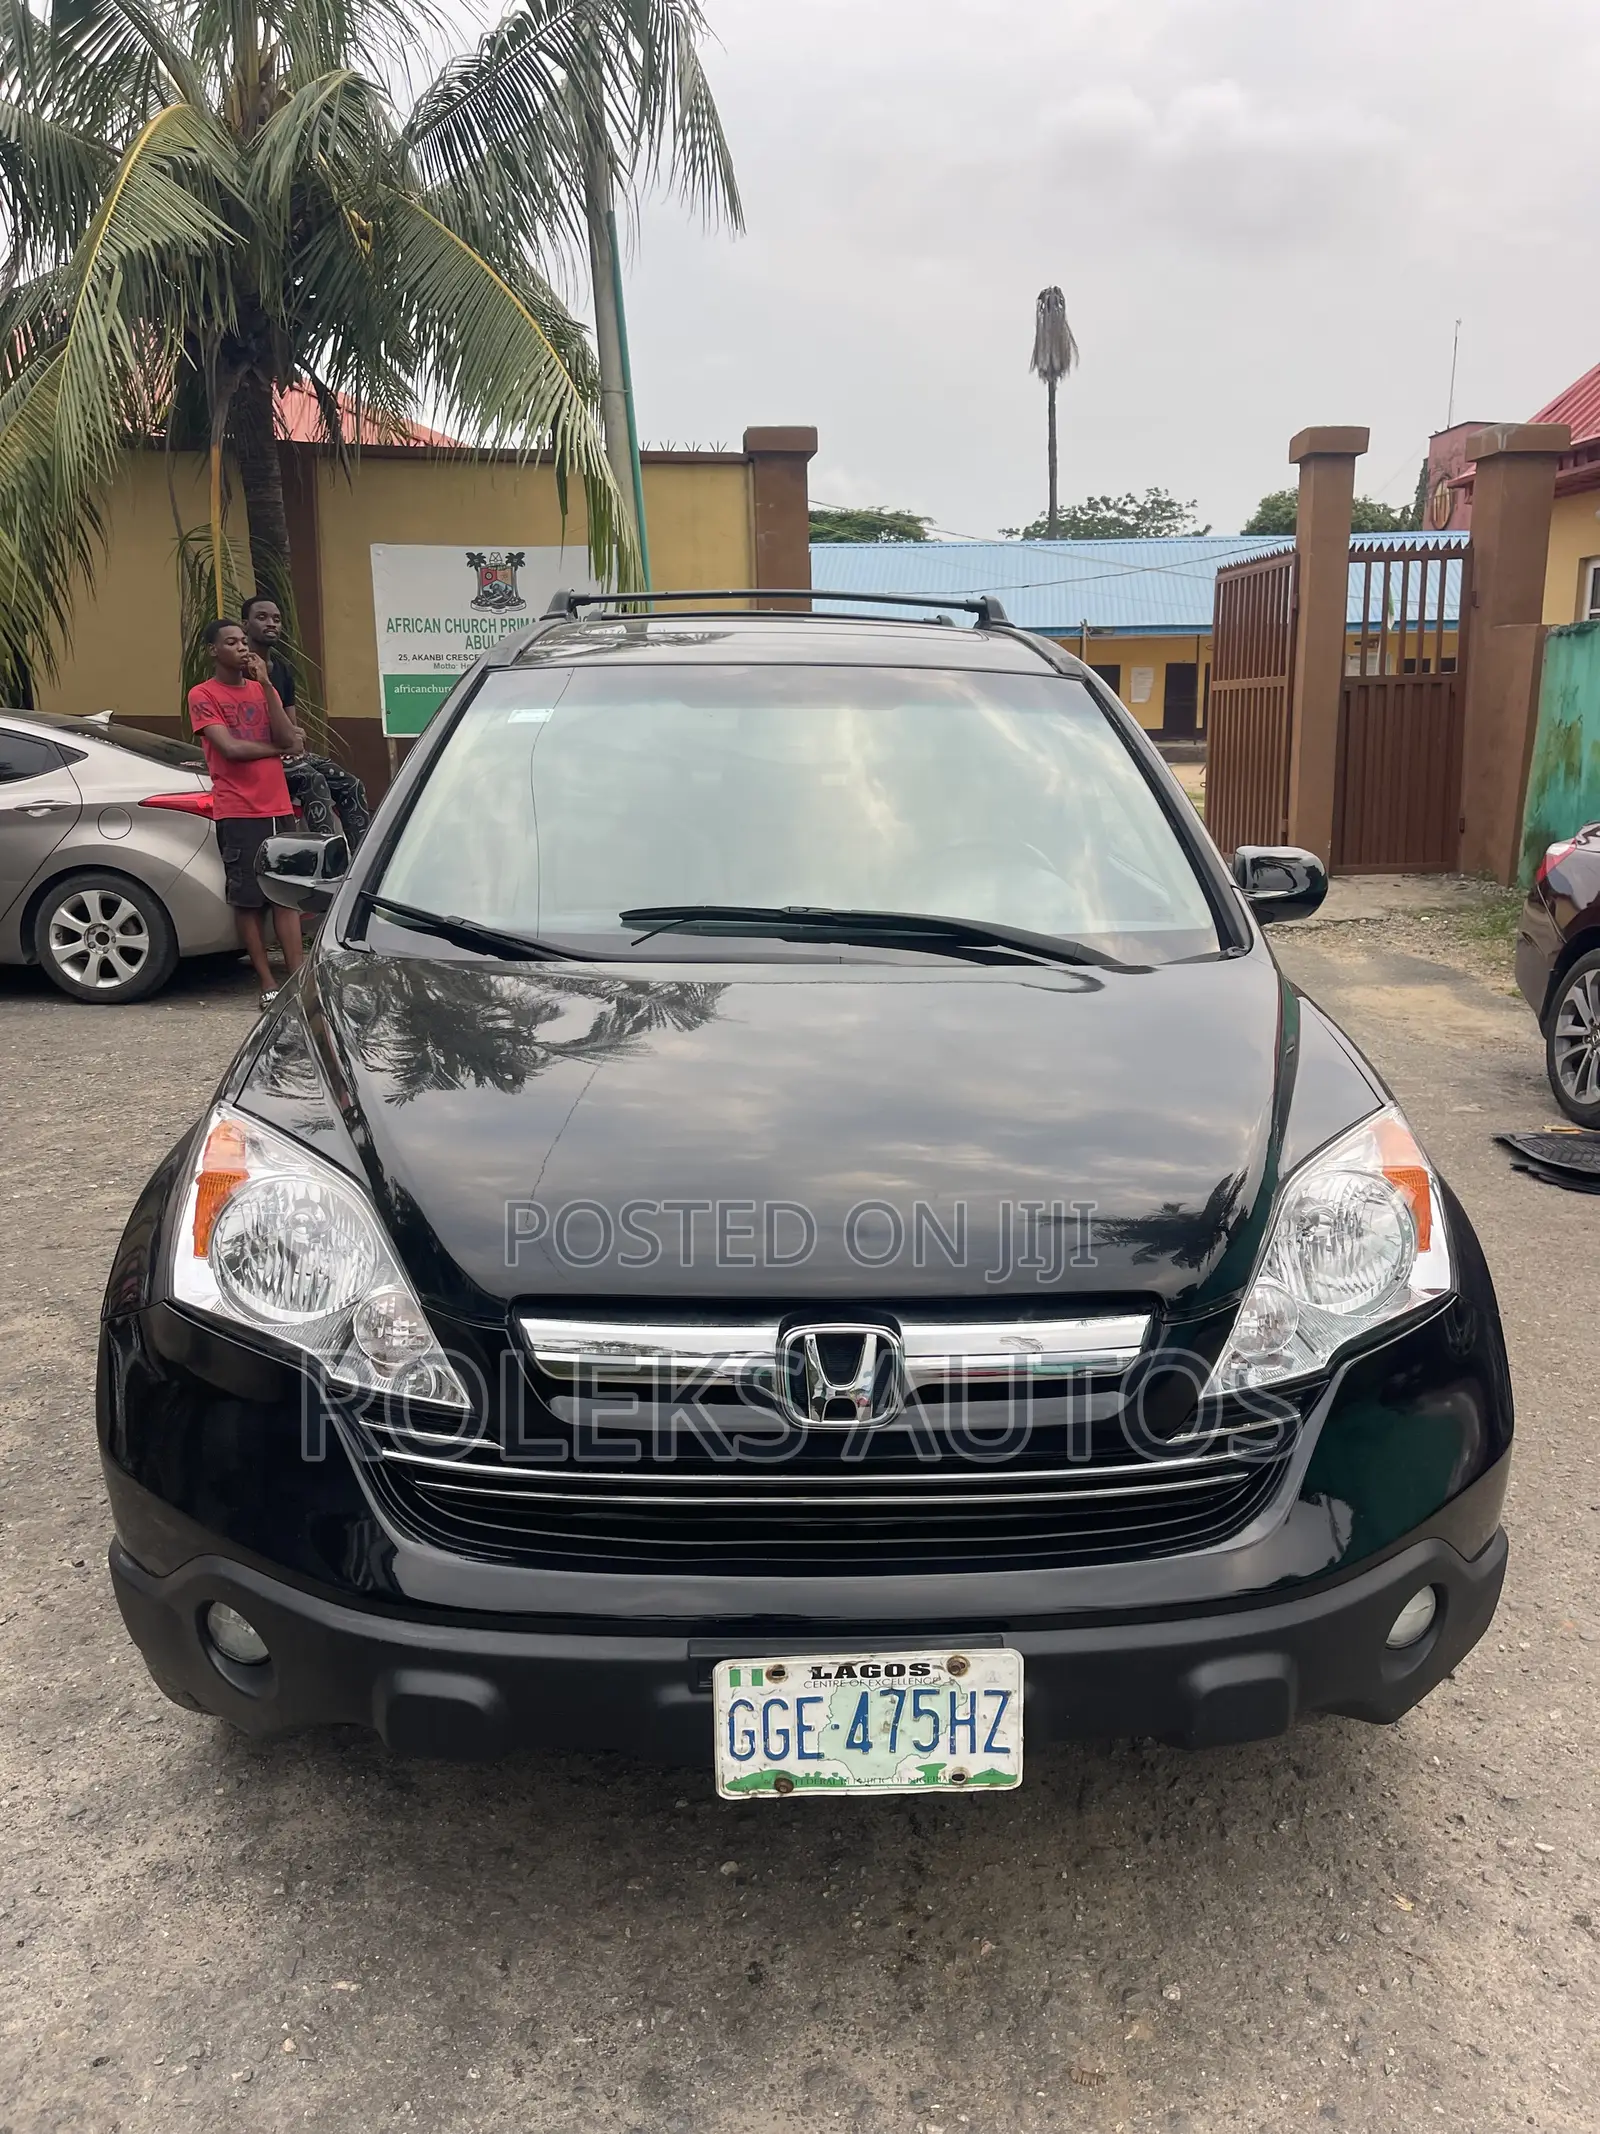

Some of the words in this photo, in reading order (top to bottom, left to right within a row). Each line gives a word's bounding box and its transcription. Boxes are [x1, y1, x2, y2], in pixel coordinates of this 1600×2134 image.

[387, 617, 441, 633] AFRICAN
[445, 617, 497, 634] CHURCH
[398, 653, 411, 662] 25,
[412, 653, 444, 661] AKANBI
[810, 1662, 931, 1680] LAGOS
[803, 1679, 845, 1690] CENTRE
[849, 1678, 864, 1688] OF
